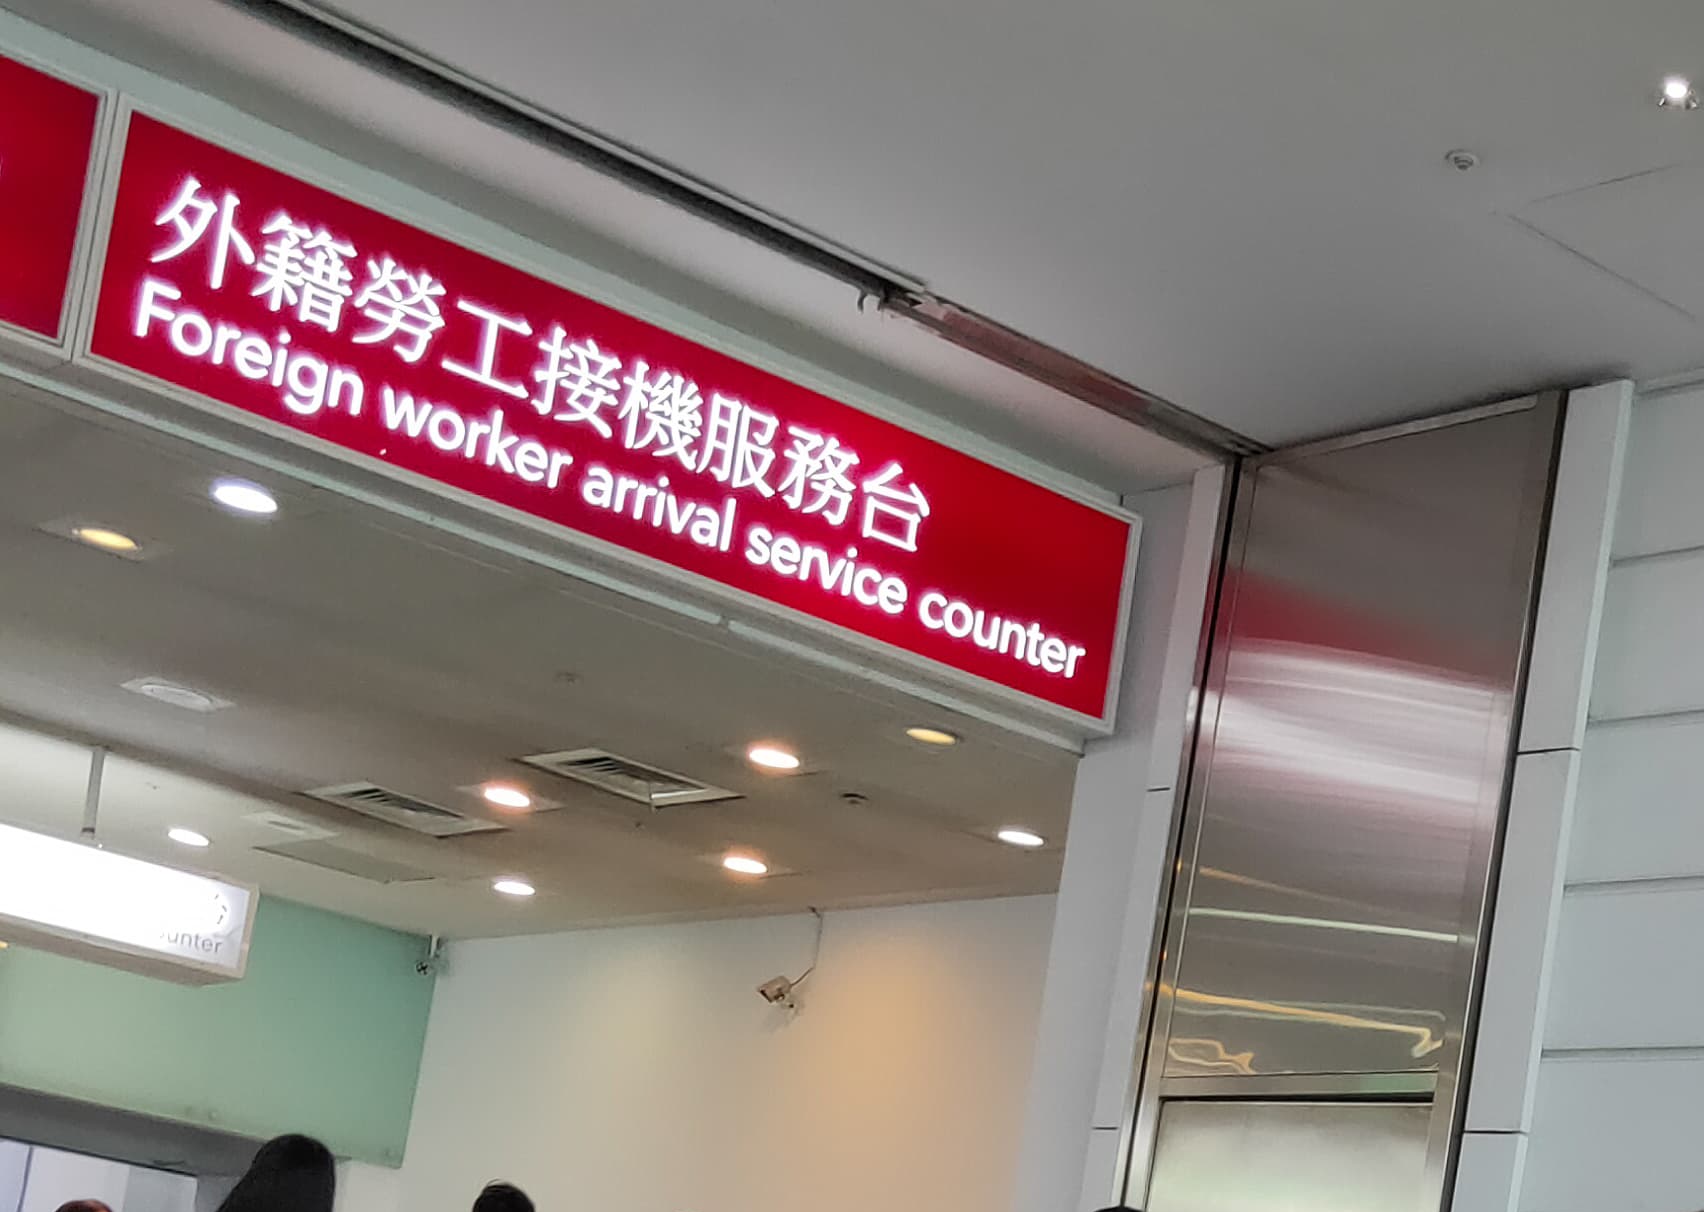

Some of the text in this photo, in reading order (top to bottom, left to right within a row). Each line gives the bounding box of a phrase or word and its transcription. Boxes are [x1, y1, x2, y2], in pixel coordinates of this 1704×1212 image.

[134, 280, 1087, 679] Foreign worker arrival service counter
[149, 176, 931, 553] 外籍勞工接機服務台
